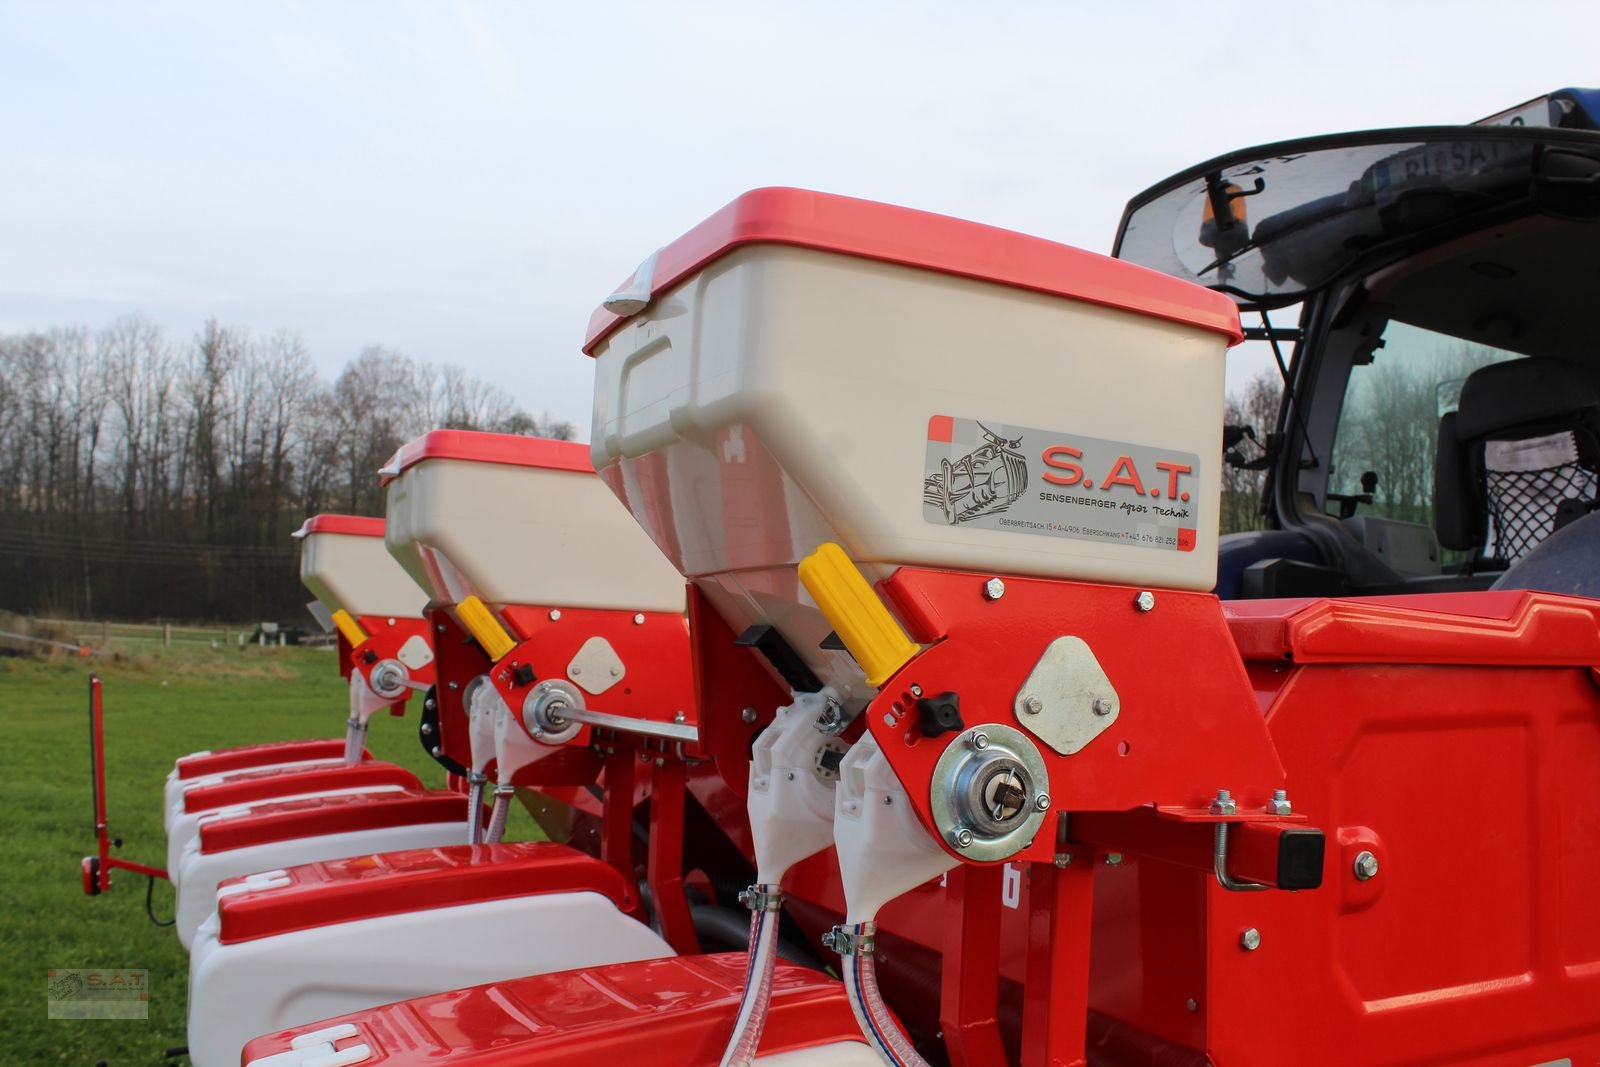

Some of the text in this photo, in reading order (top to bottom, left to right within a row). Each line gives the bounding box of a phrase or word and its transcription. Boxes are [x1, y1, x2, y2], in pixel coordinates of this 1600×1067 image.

[1041, 444, 1192, 502] S.A.T.
[1039, 492, 1116, 509] SENSENBERGER
[1152, 505, 1190, 520] Technik
[1142, 534, 1153, 543] 676
[1165, 537, 1176, 545] 252
